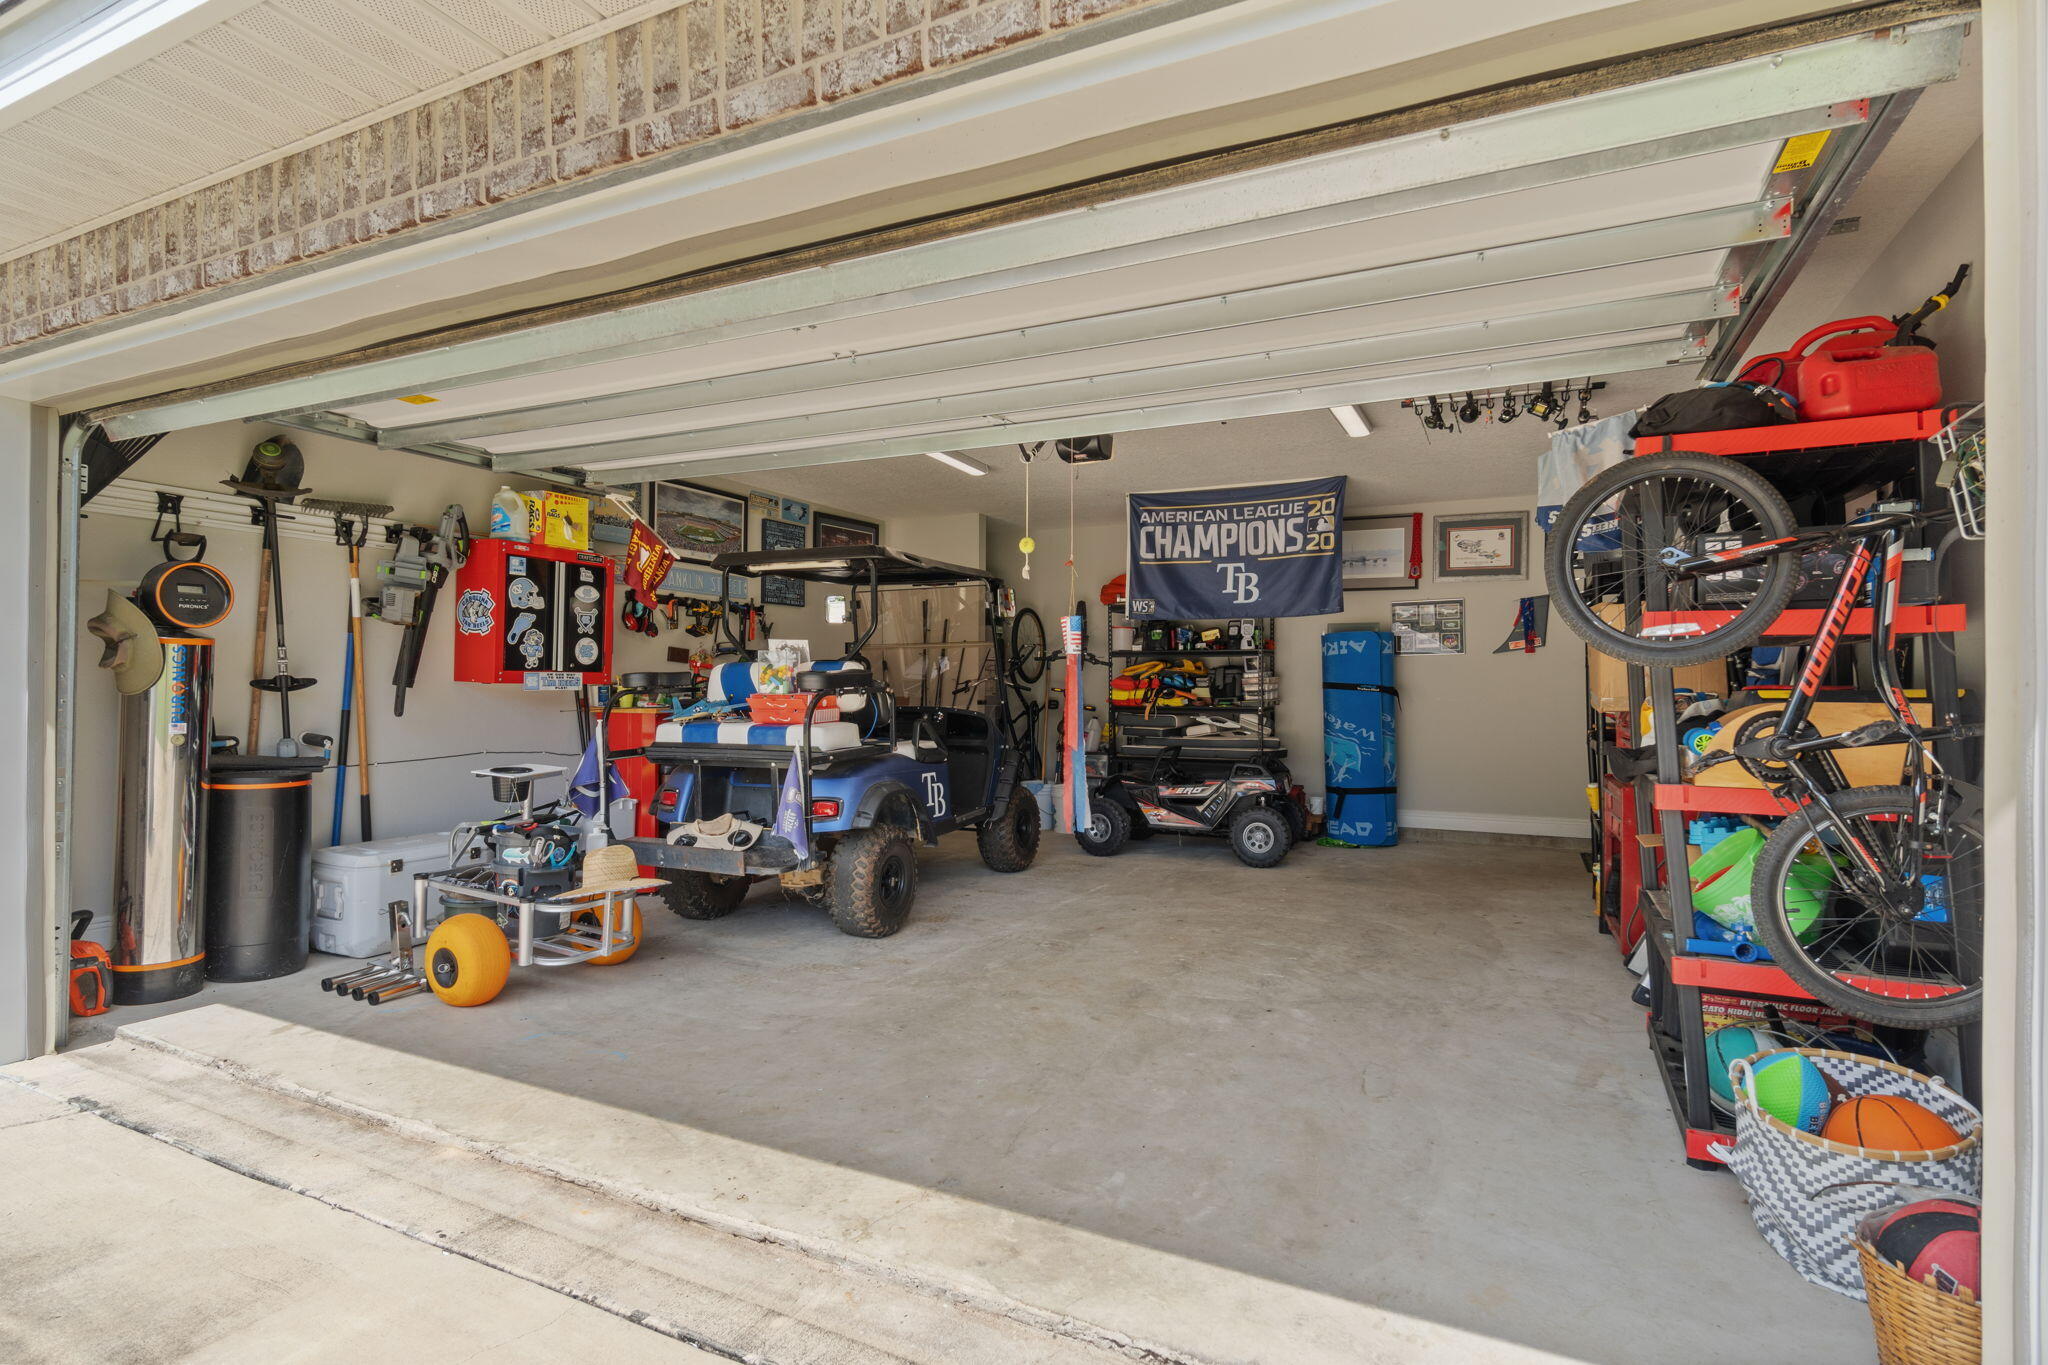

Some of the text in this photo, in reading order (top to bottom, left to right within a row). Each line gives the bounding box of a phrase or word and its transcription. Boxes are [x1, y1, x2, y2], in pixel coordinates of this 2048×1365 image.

[547, 511, 561, 519] RAGS
[1139, 501, 1305, 524] AMERICAN LEAGUE
[1307, 497, 1336, 518] 20
[1139, 516, 1304, 560] CHAMPIONS
[1305, 532, 1335, 551] 20
[577, 553, 604, 564] CRAFTSMAN
[711, 575, 743, 595] STEET
[1216, 562, 1261, 604] TB
[171, 644, 188, 728] PURONICS
[921, 771, 947, 818] TB
[1327, 821, 1373, 837] EAD
[1790, 1004, 1819, 1014] FLOOR
[1821, 1007, 1843, 1017] JACK
